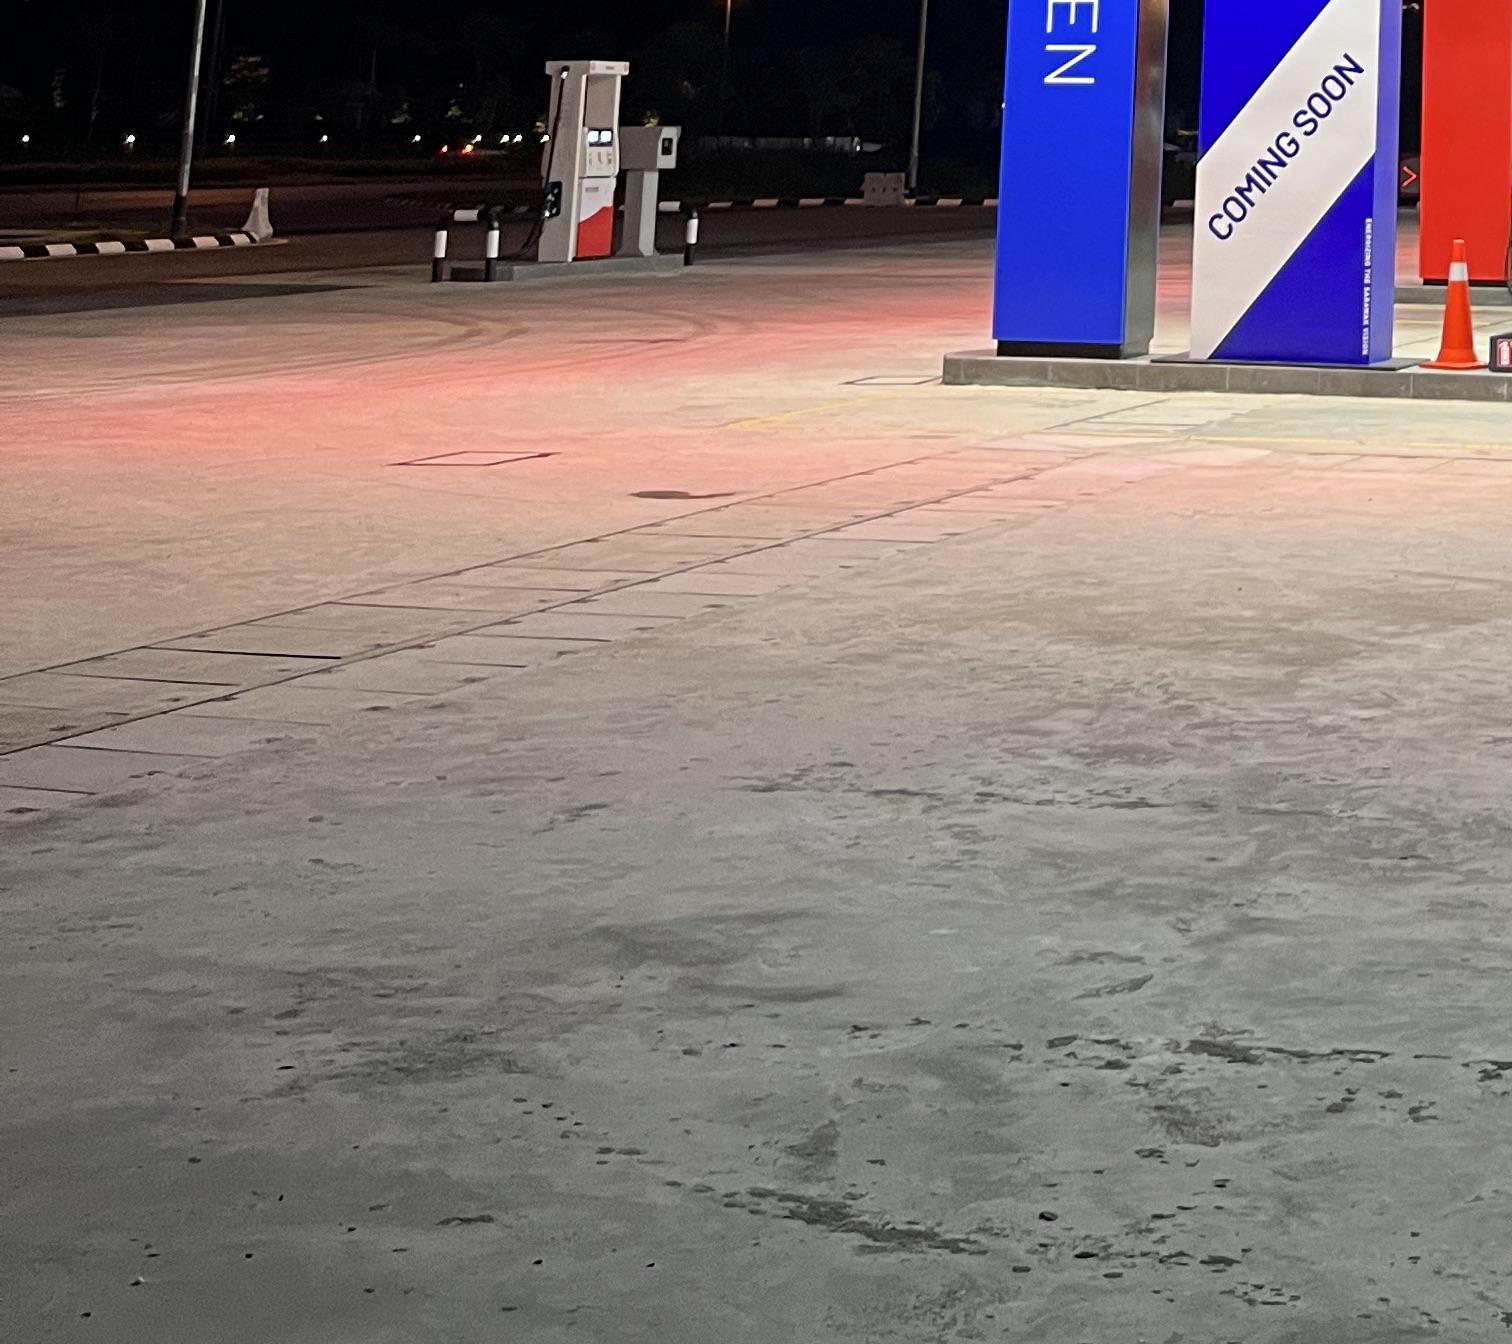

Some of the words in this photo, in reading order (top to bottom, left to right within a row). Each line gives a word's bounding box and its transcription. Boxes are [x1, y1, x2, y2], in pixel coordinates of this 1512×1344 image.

[1208, 131, 1300, 240] COMING
[1292, 52, 1365, 137] SOON
[1363, 268, 1372, 284] THE
[1362, 286, 1371, 326] SARAWAK
[1361, 326, 1369, 356] VISION
